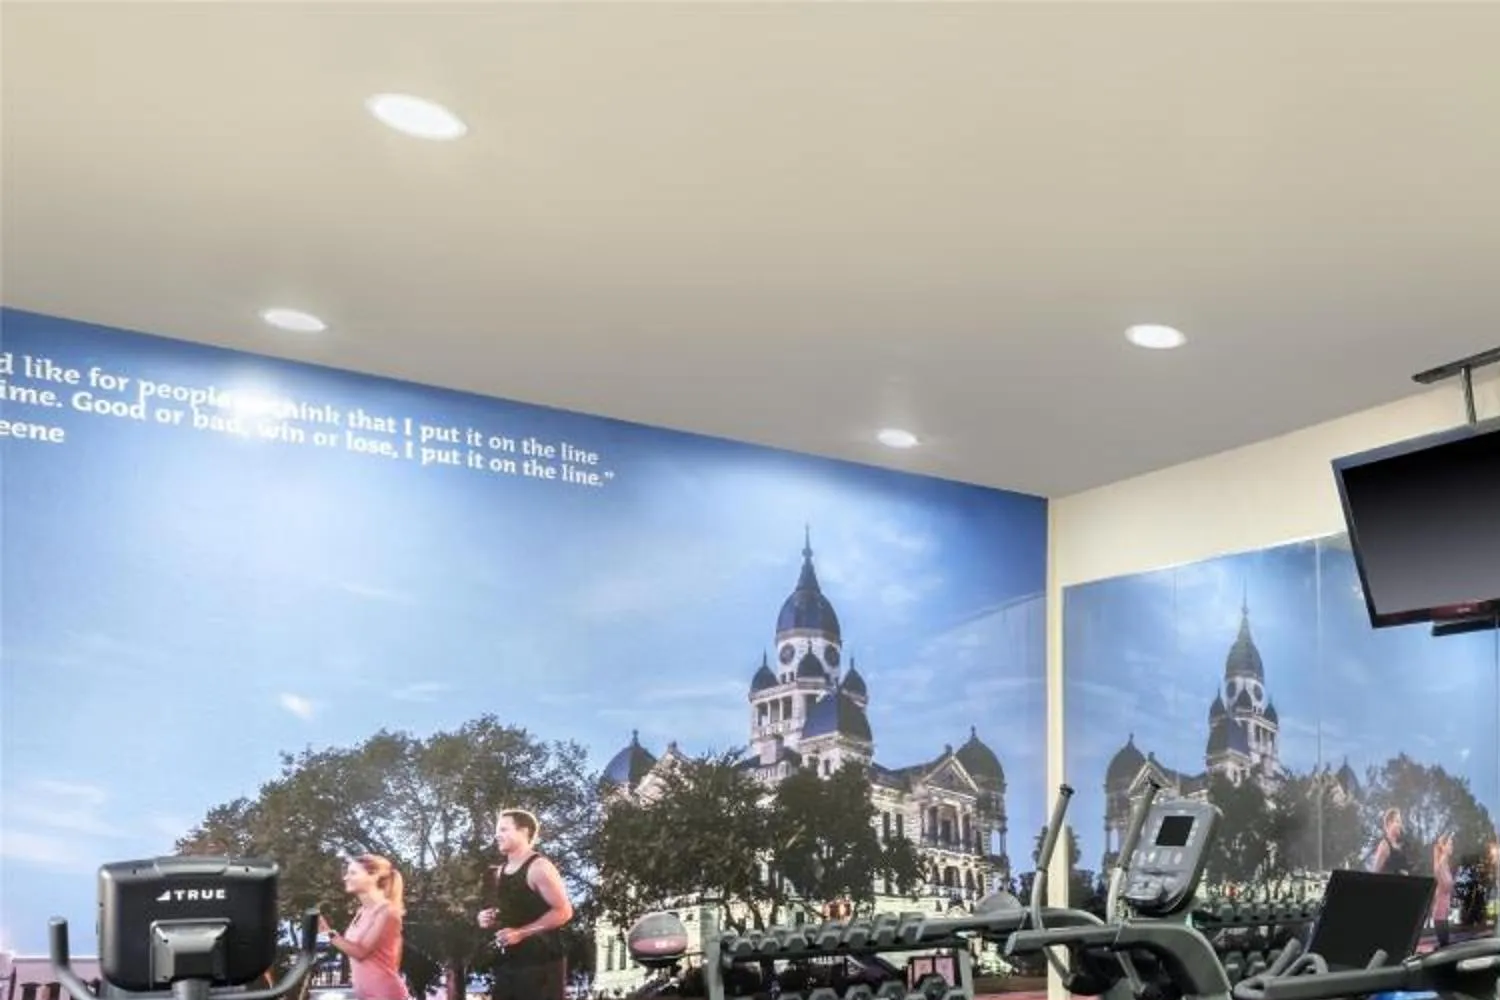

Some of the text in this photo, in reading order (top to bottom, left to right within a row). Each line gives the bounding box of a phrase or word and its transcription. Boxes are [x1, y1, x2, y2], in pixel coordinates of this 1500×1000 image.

[0, 379, 63, 408] ime.
[71, 391, 146, 420] Good
[155, 408, 184, 425] or
[257, 420, 305, 444] win
[313, 431, 338, 447] or
[404, 441, 413, 460] I
[421, 446, 461, 466] put
[467, 449, 484, 469] it
[490, 457, 516, 474] on
[523, 459, 557, 479] the
[0, 418, 65, 443] eene
[24, 355, 81, 385] like
[90, 366, 129, 392] for
[276, 394, 341, 425] hink
[348, 407, 397, 433] that
[404, 417, 413, 436] I
[420, 424, 460, 443] put
[466, 427, 483, 447] it
[489, 436, 515, 452] on
[522, 437, 556, 459] the
[561, 442, 600, 465] line
[173, 888, 226, 901] TRUE
